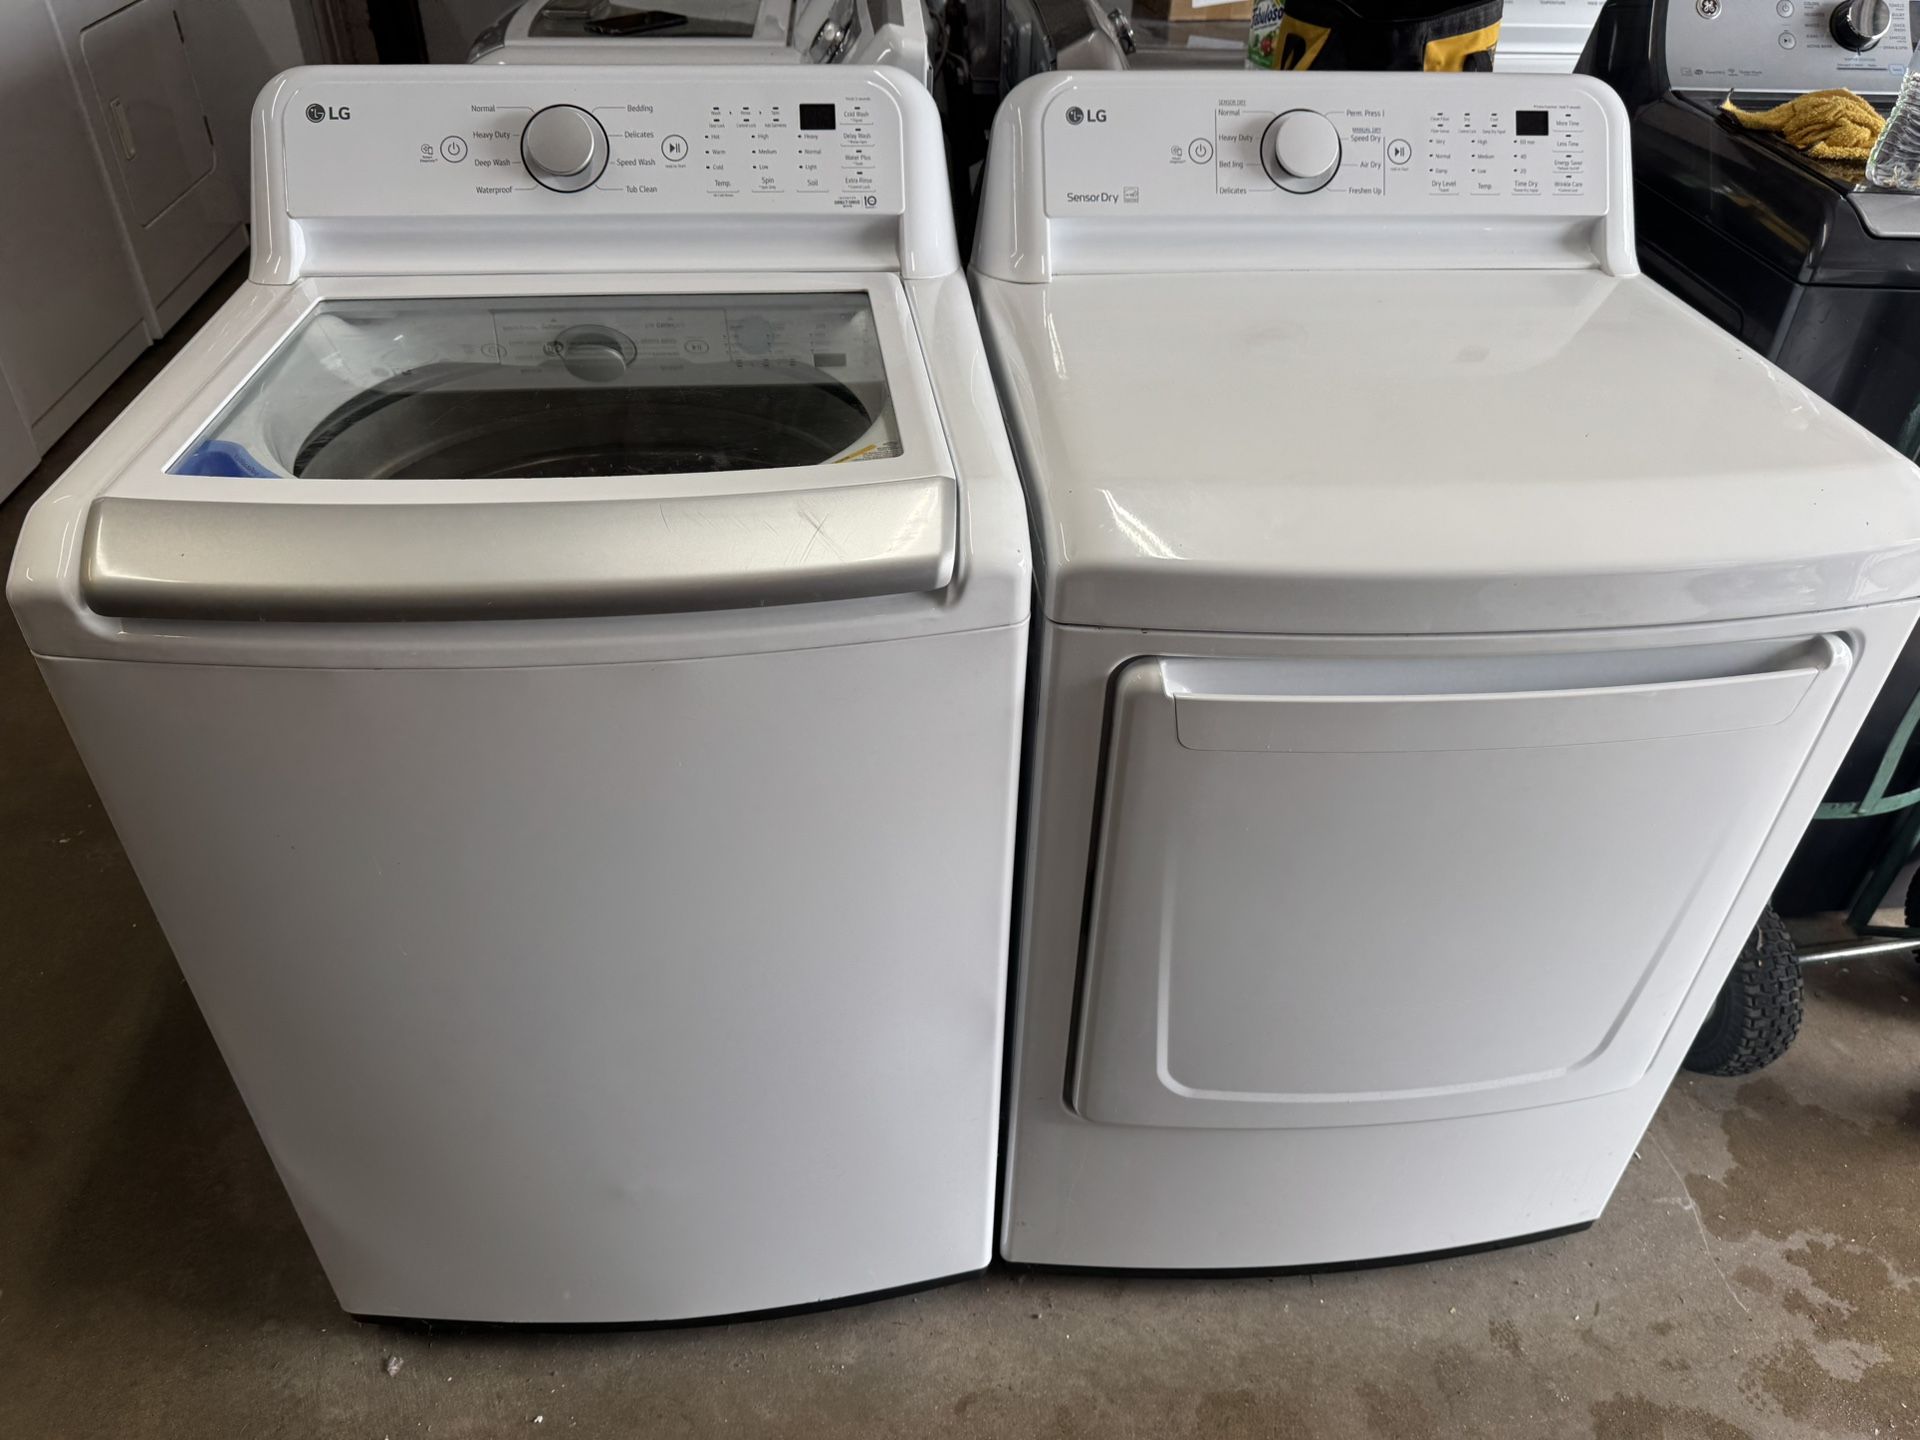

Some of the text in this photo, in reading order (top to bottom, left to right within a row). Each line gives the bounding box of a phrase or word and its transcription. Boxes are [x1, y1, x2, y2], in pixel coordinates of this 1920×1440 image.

[1251, 4, 1285, 29] Fabuloso
[471, 104, 496, 113] Normal
[627, 104, 654, 114] Bedding
[1364, 109, 1381, 117] Press
[329, 107, 351, 121] LG
[1086, 109, 1107, 122] LG
[473, 130, 511, 140] Heavy Duty
[624, 130, 655, 139] Delicates
[1218, 134, 1253, 142] Heavy Duty
[474, 158, 511, 168] Deep Wash
[616, 158, 637, 167] Speed
[637, 158, 656, 166] Wash
[1219, 160, 1244, 169] Bedding
[1370, 161, 1382, 169] Dry
[761, 176, 775, 185] Spin
[1431, 180, 1442, 188] Dry
[1528, 180, 1538, 188] Dry
[475, 185, 513, 195] Waterproof
[626, 185, 658, 193] Tub Clean
[1373, 187, 1382, 195] Up
[1066, 192, 1100, 202] Sensor
[1101, 192, 1119, 203] Dry
